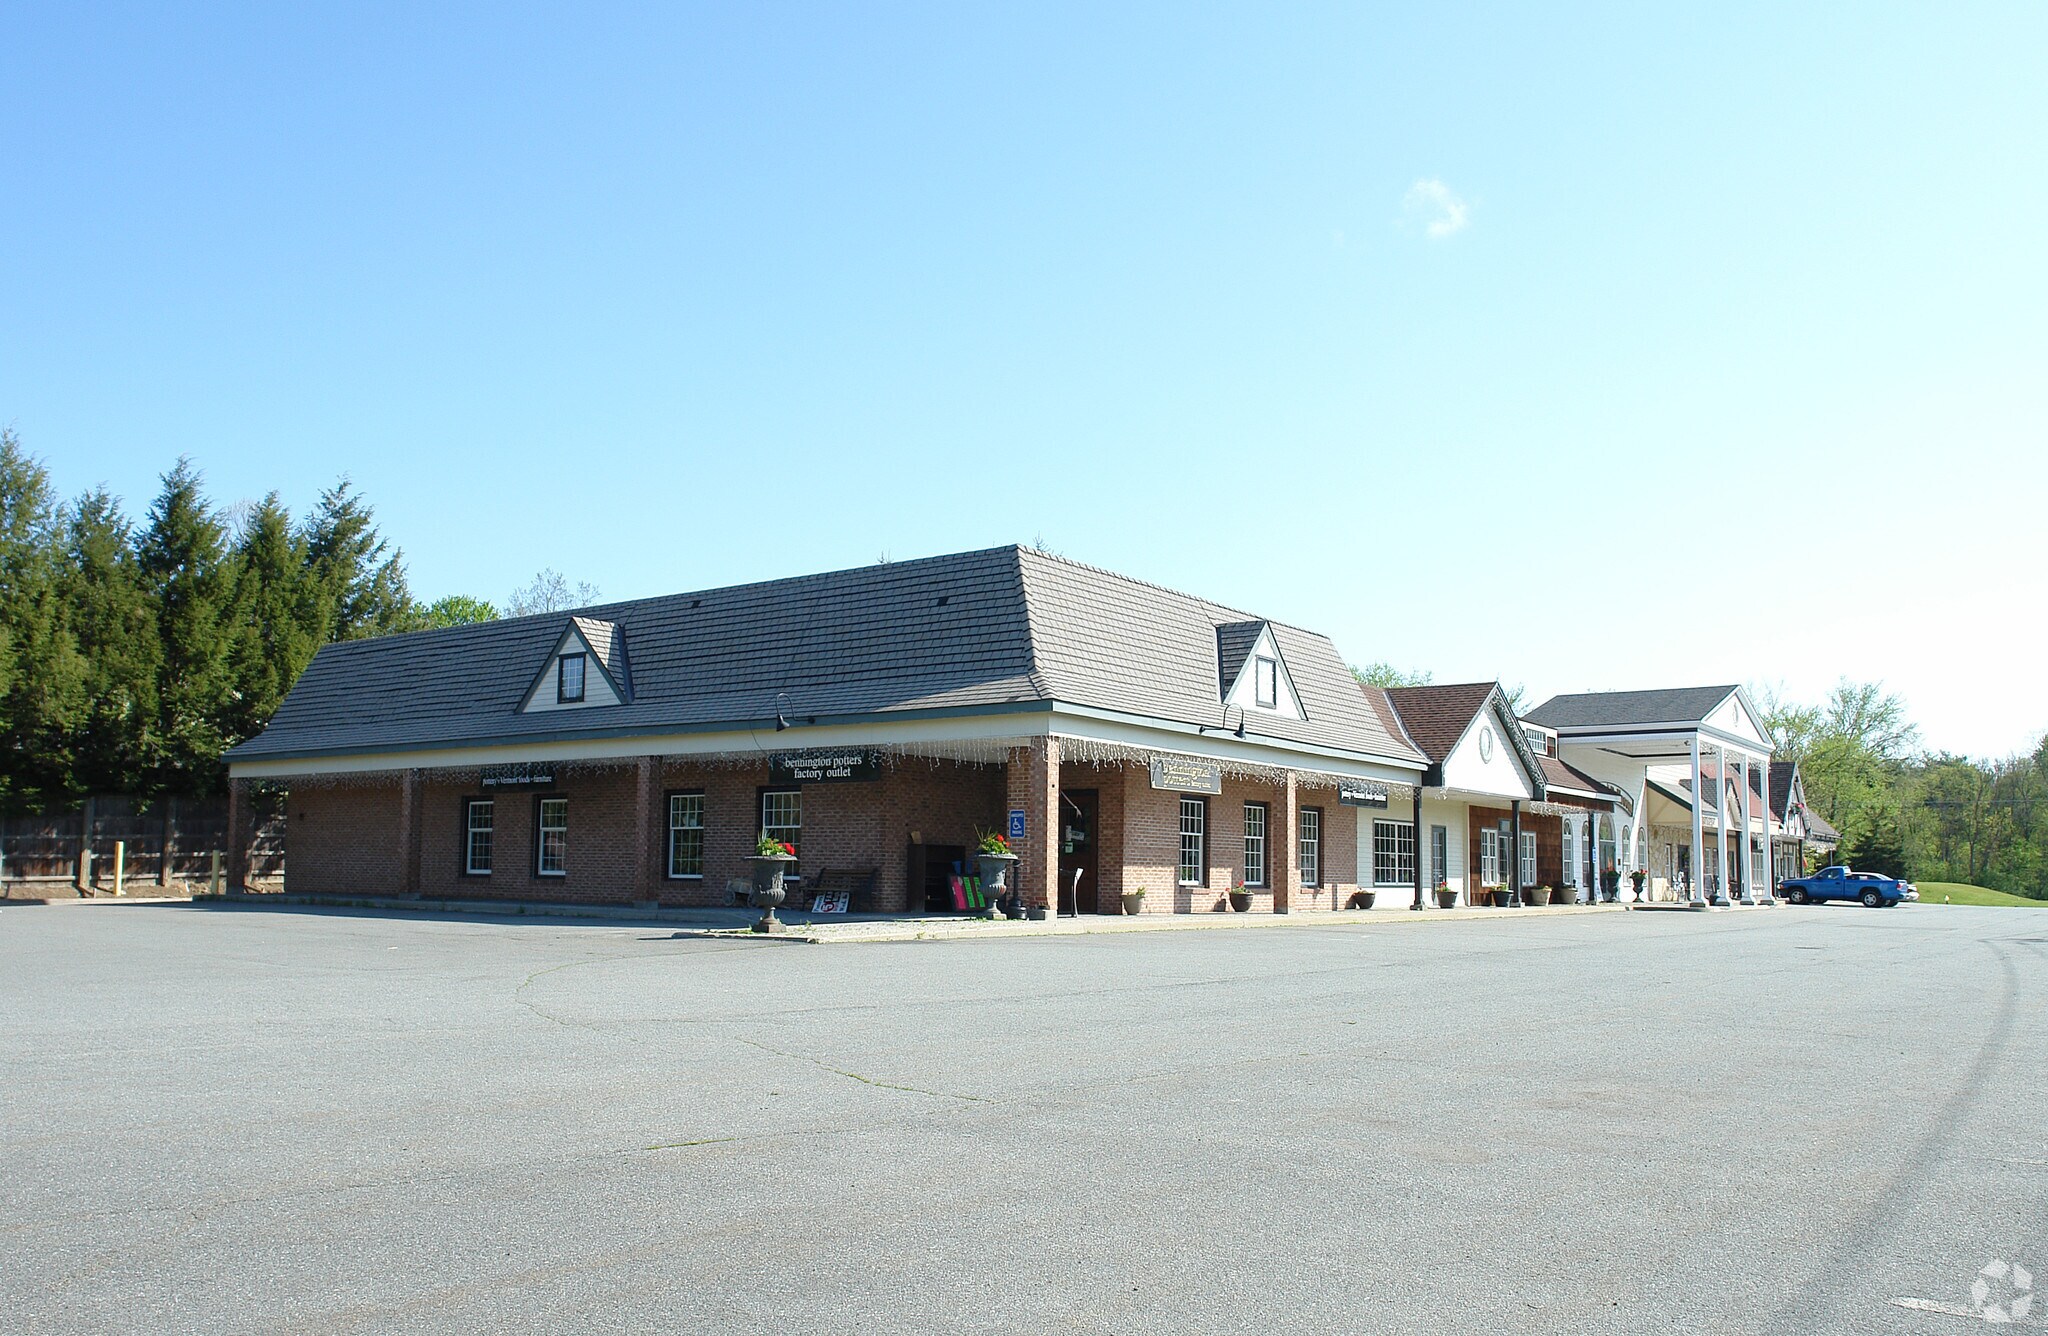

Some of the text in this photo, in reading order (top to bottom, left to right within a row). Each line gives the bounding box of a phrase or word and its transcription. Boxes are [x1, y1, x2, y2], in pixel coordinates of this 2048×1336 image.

[785, 756, 862, 769] bennington potters
[794, 767, 851, 780] factory outlet
